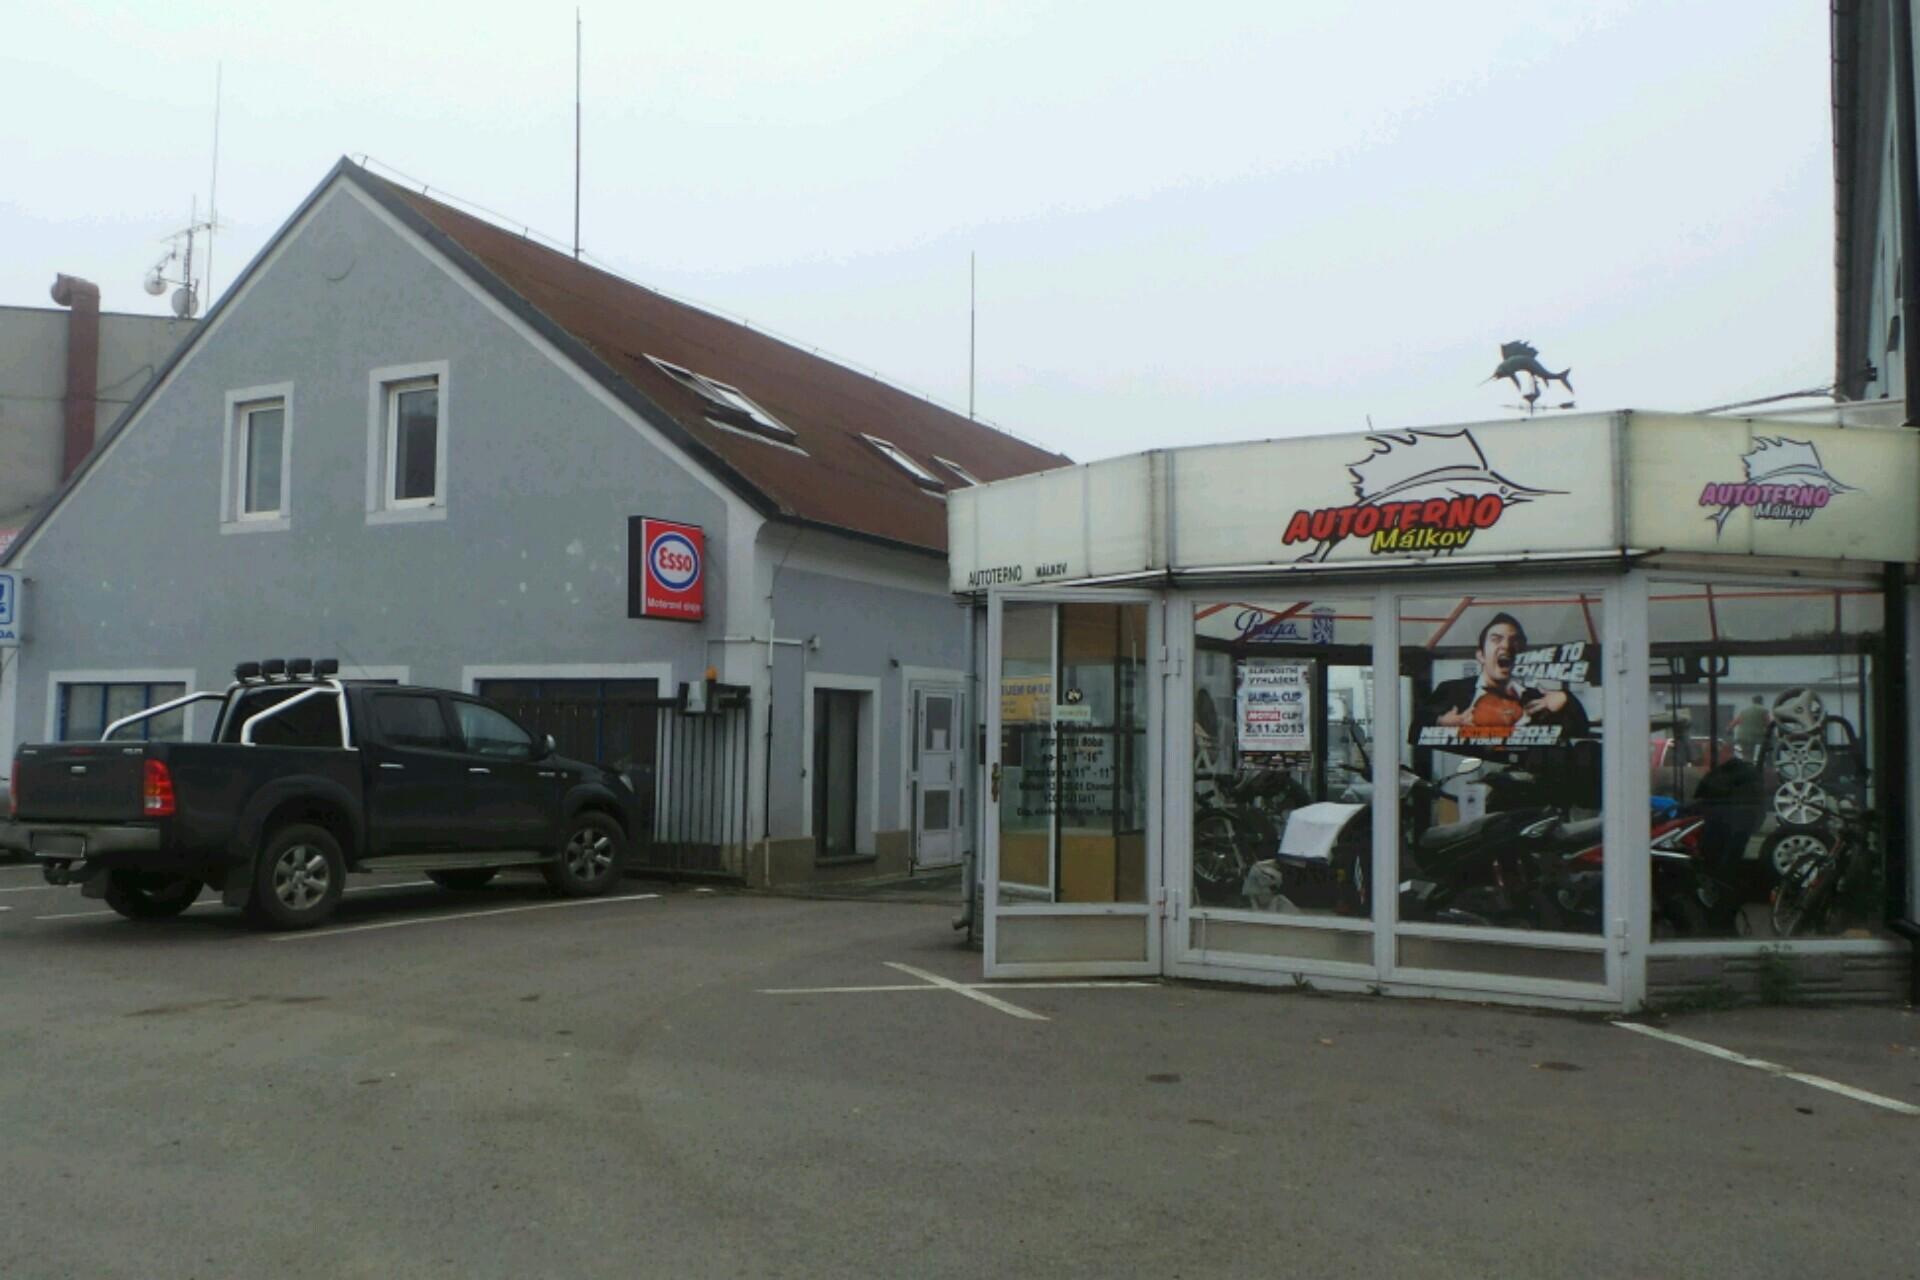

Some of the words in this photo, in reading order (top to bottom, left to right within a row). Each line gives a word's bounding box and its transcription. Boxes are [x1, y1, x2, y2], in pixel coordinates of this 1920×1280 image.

[1698, 482, 1831, 508] AUTOTERNO
[1282, 494, 1503, 544] AUTOTERNO
[1372, 528, 1473, 552] Málkov
[658, 546, 692, 573] Esso
[968, 565, 1022, 588] AUTOTERNO
[1514, 647, 1557, 665] TIME
[1560, 642, 1586, 662] TO
